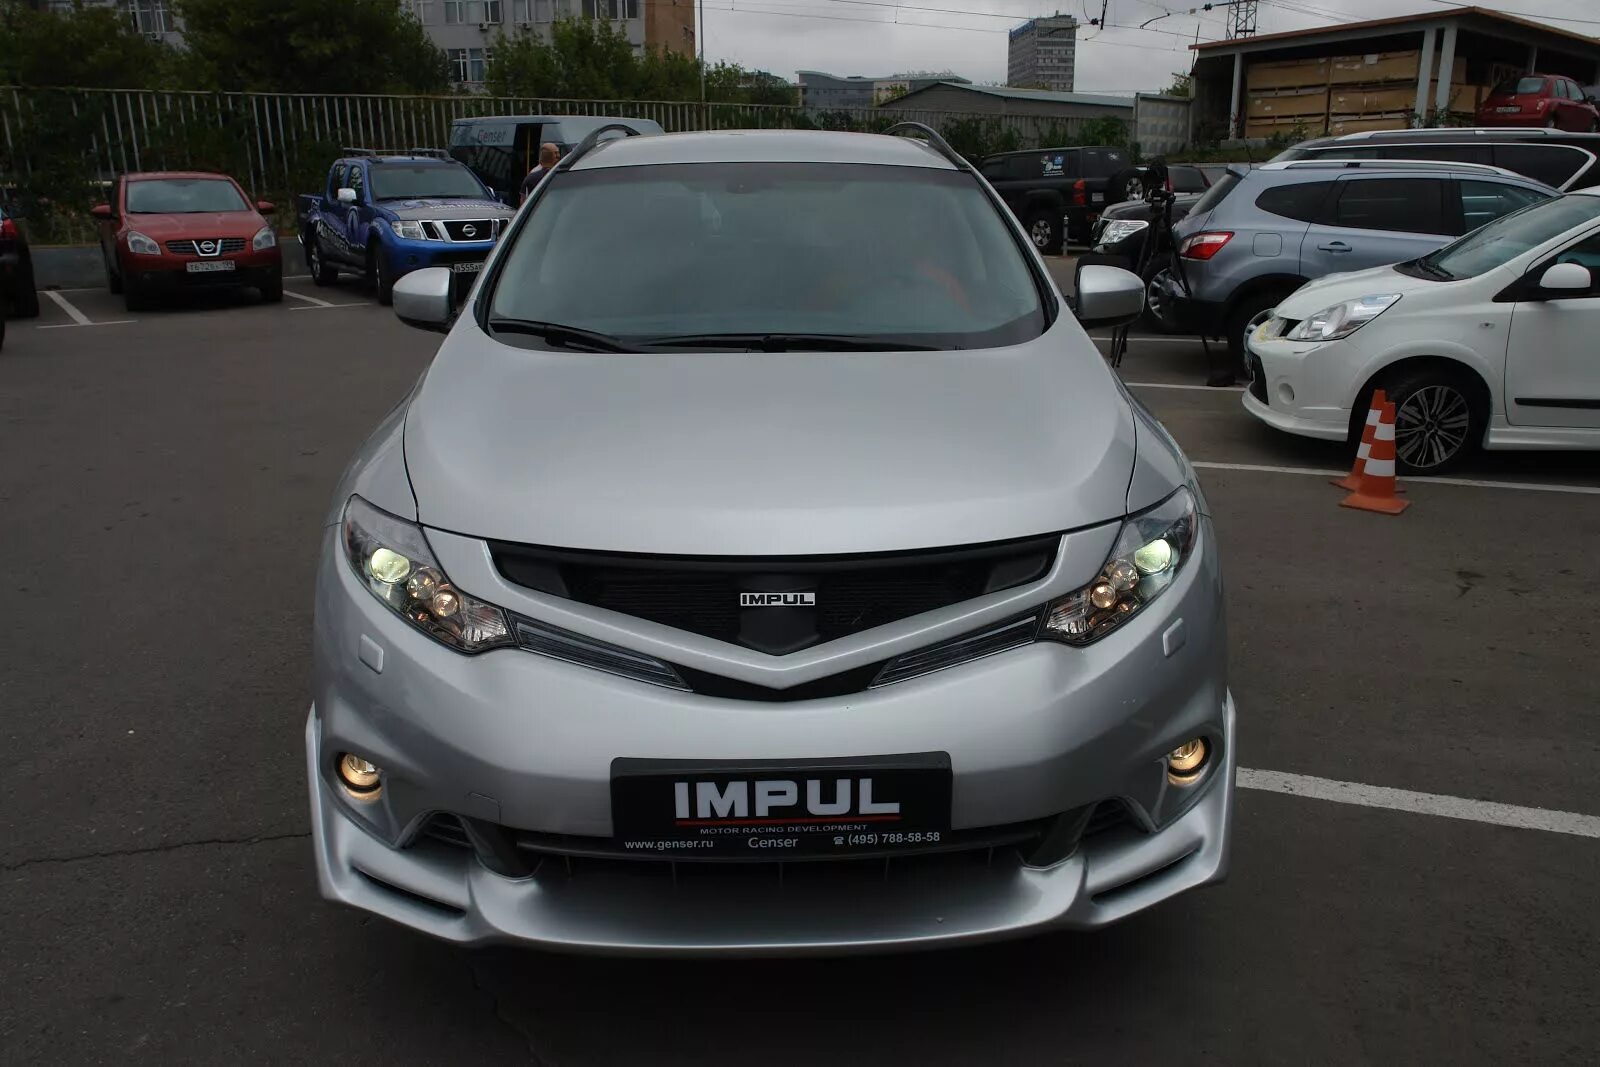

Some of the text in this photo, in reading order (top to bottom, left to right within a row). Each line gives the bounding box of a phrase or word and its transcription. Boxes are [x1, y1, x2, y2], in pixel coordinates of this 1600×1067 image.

[741, 593, 815, 605] IMPUL
[674, 778, 900, 819] IMPUL
[700, 824, 868, 835] MOTOR RACING DEVELOPMENT
[624, 839, 714, 850] www.genser.ru
[748, 836, 799, 848] Genser
[848, 832, 940, 846] (495) 788-58-58
